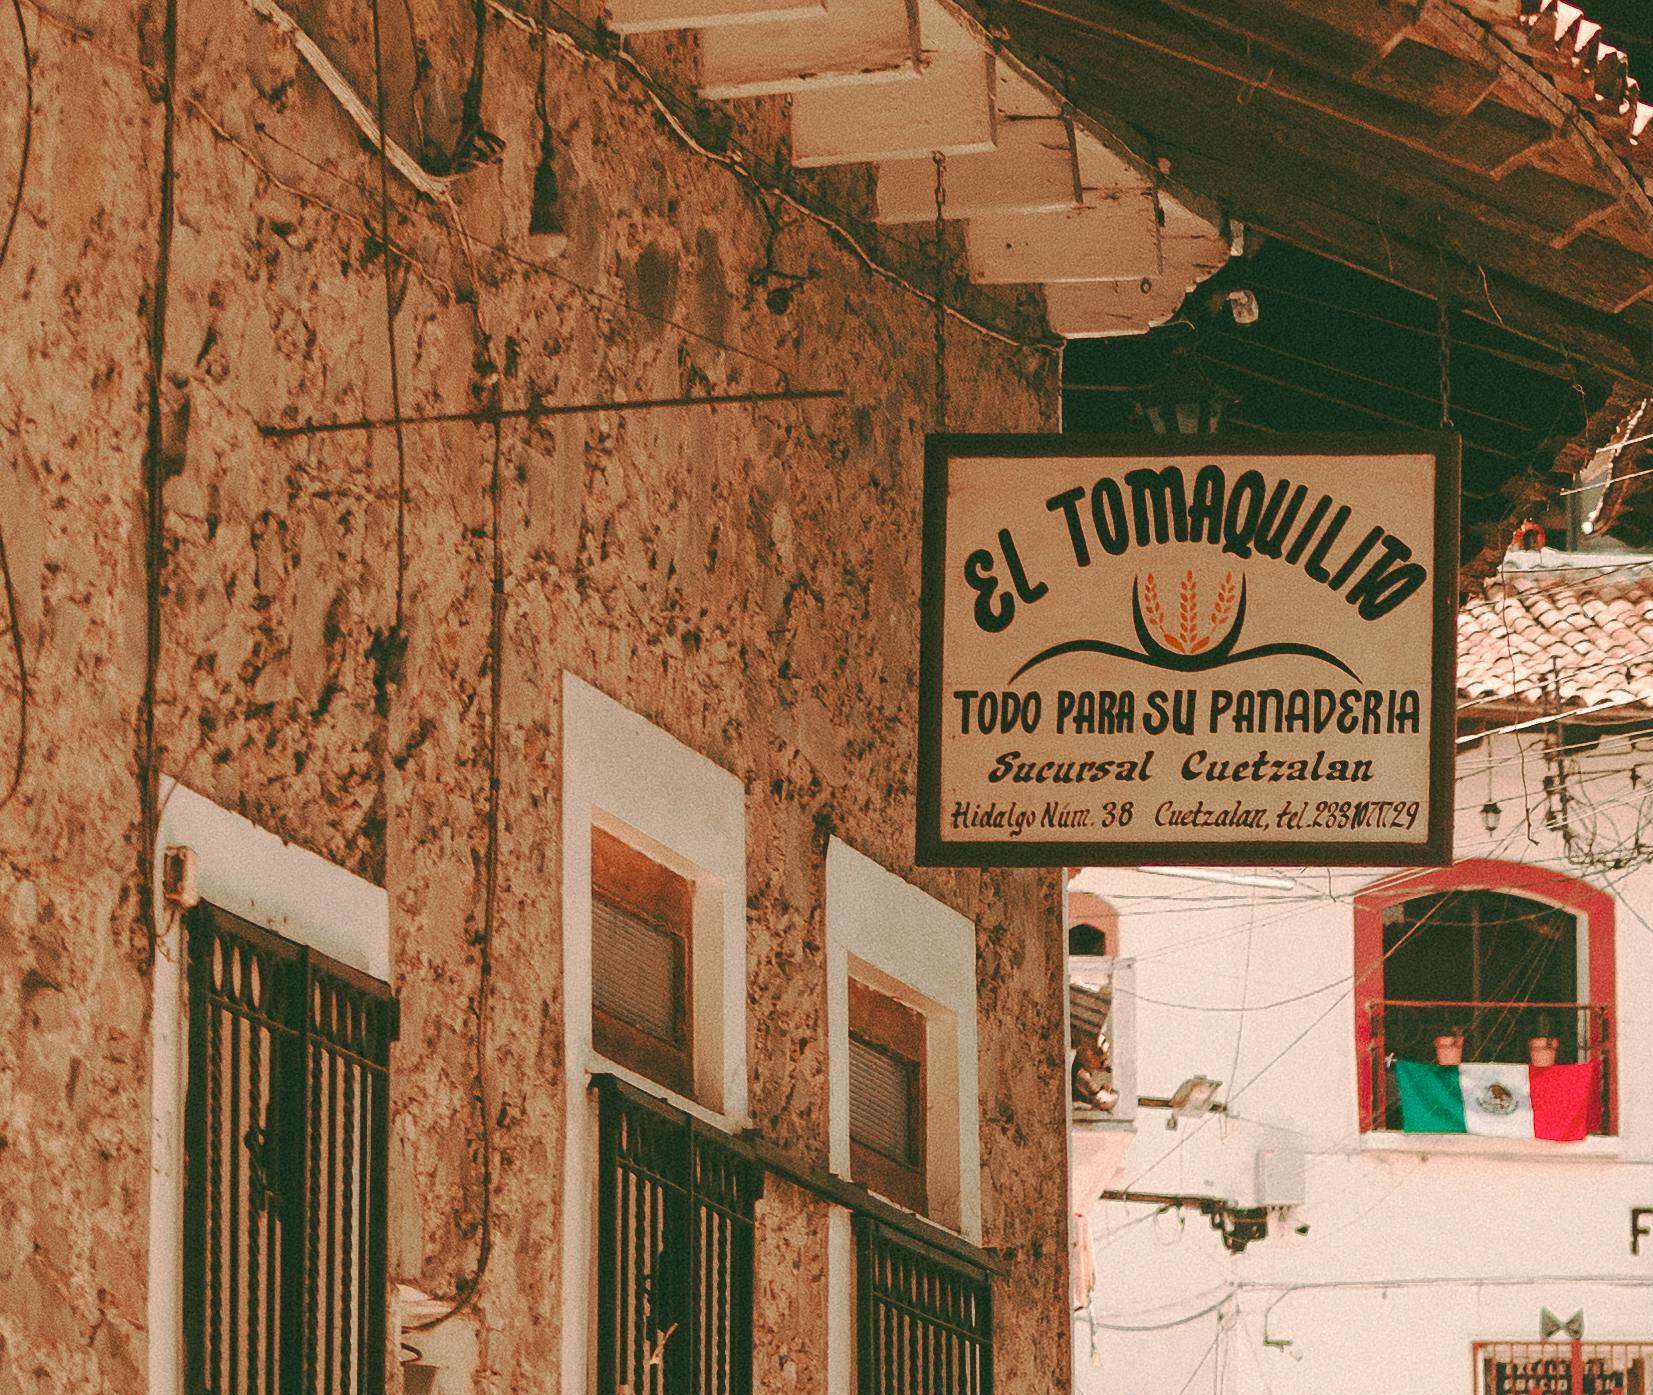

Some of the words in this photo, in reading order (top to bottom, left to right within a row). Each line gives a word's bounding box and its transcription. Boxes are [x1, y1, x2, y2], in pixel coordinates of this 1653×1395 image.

[963, 528, 1049, 633] EL
[1045, 463, 1428, 621] TOMAQUILITO
[953, 690, 1042, 734] TODO
[1056, 690, 1135, 734] PARA
[1142, 689, 1196, 735] SU
[1209, 689, 1420, 734] PANADERIA
[988, 751, 1155, 784] Sucursal
[1181, 750, 1375, 783] Cuetzalan
[951, 801, 1036, 837] Hidalgo
[1041, 801, 1094, 829] Núm.
[1101, 801, 1134, 828] 38
[1154, 800, 1270, 831] Cuetzalan,
